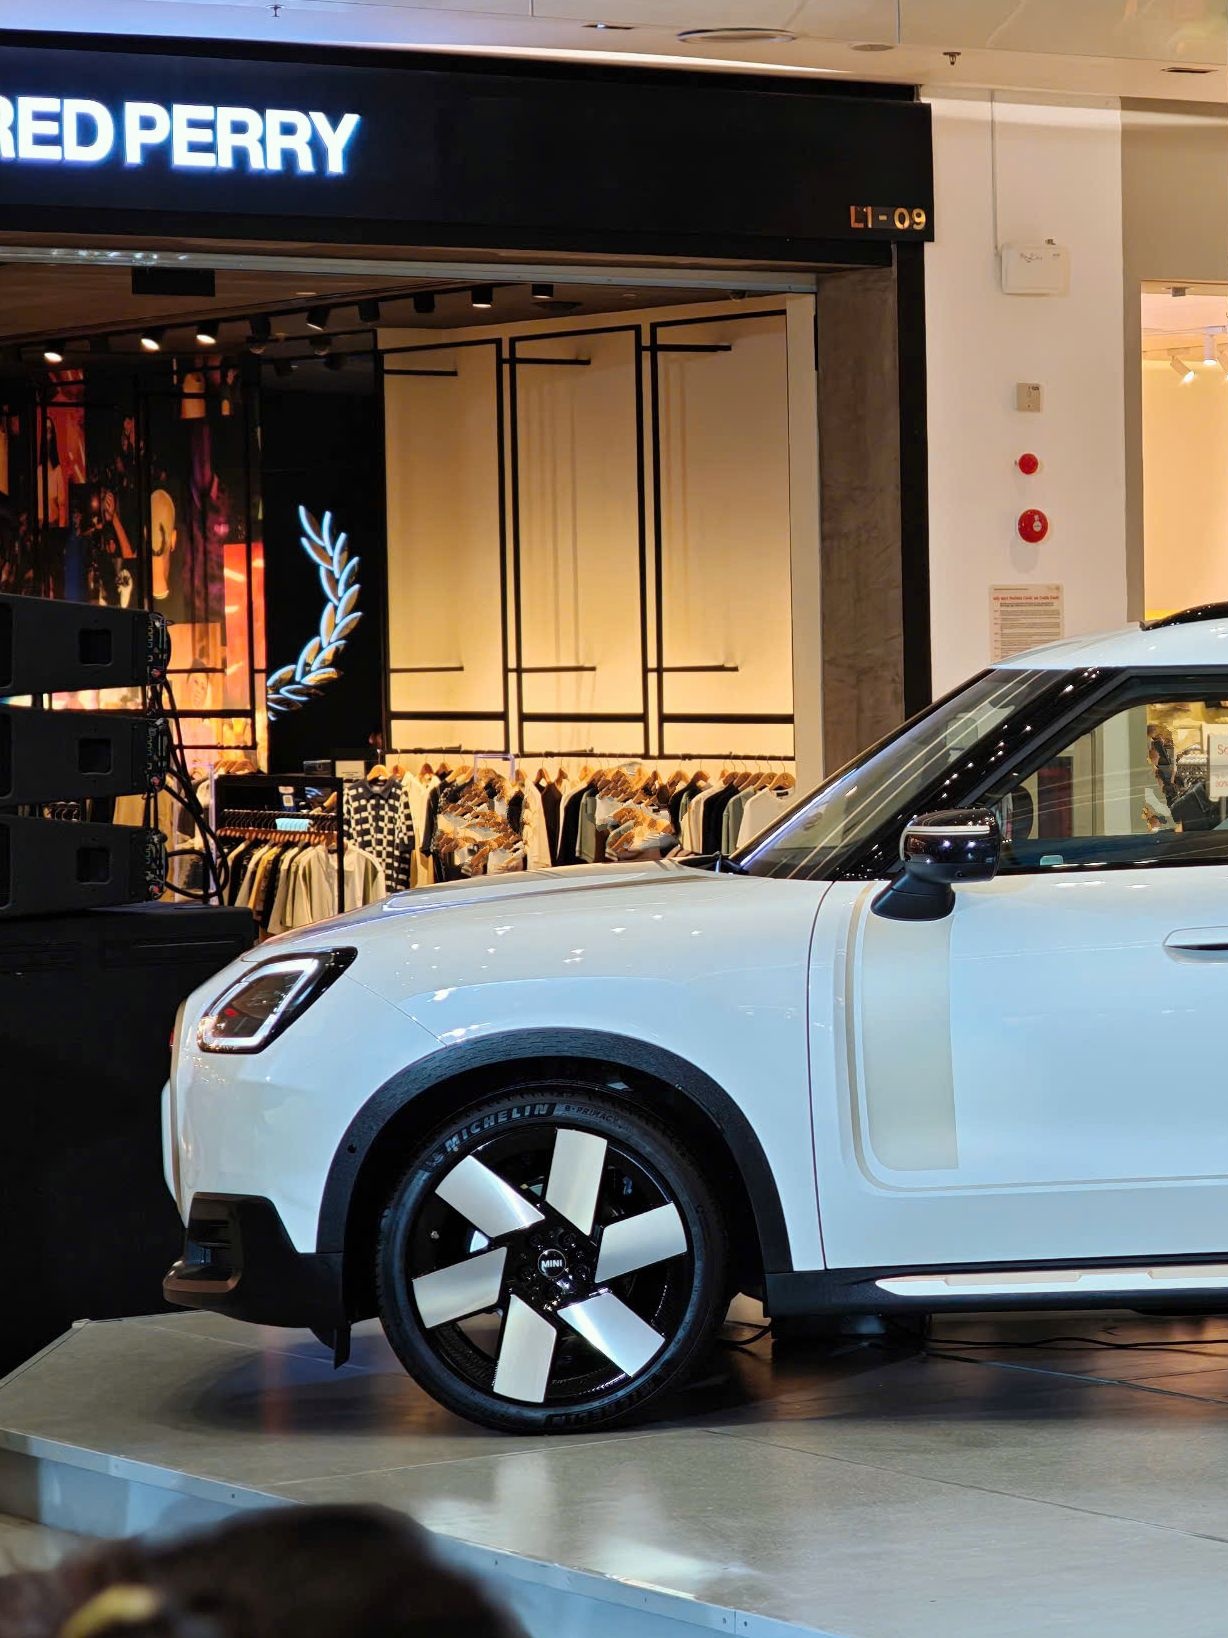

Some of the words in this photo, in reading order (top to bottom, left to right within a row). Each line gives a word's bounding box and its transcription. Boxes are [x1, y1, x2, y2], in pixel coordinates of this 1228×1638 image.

[125, 102, 361, 174] PERRY
[444, 1103, 550, 1152] MICHELIN
[541, 1259, 563, 1268] MINI
